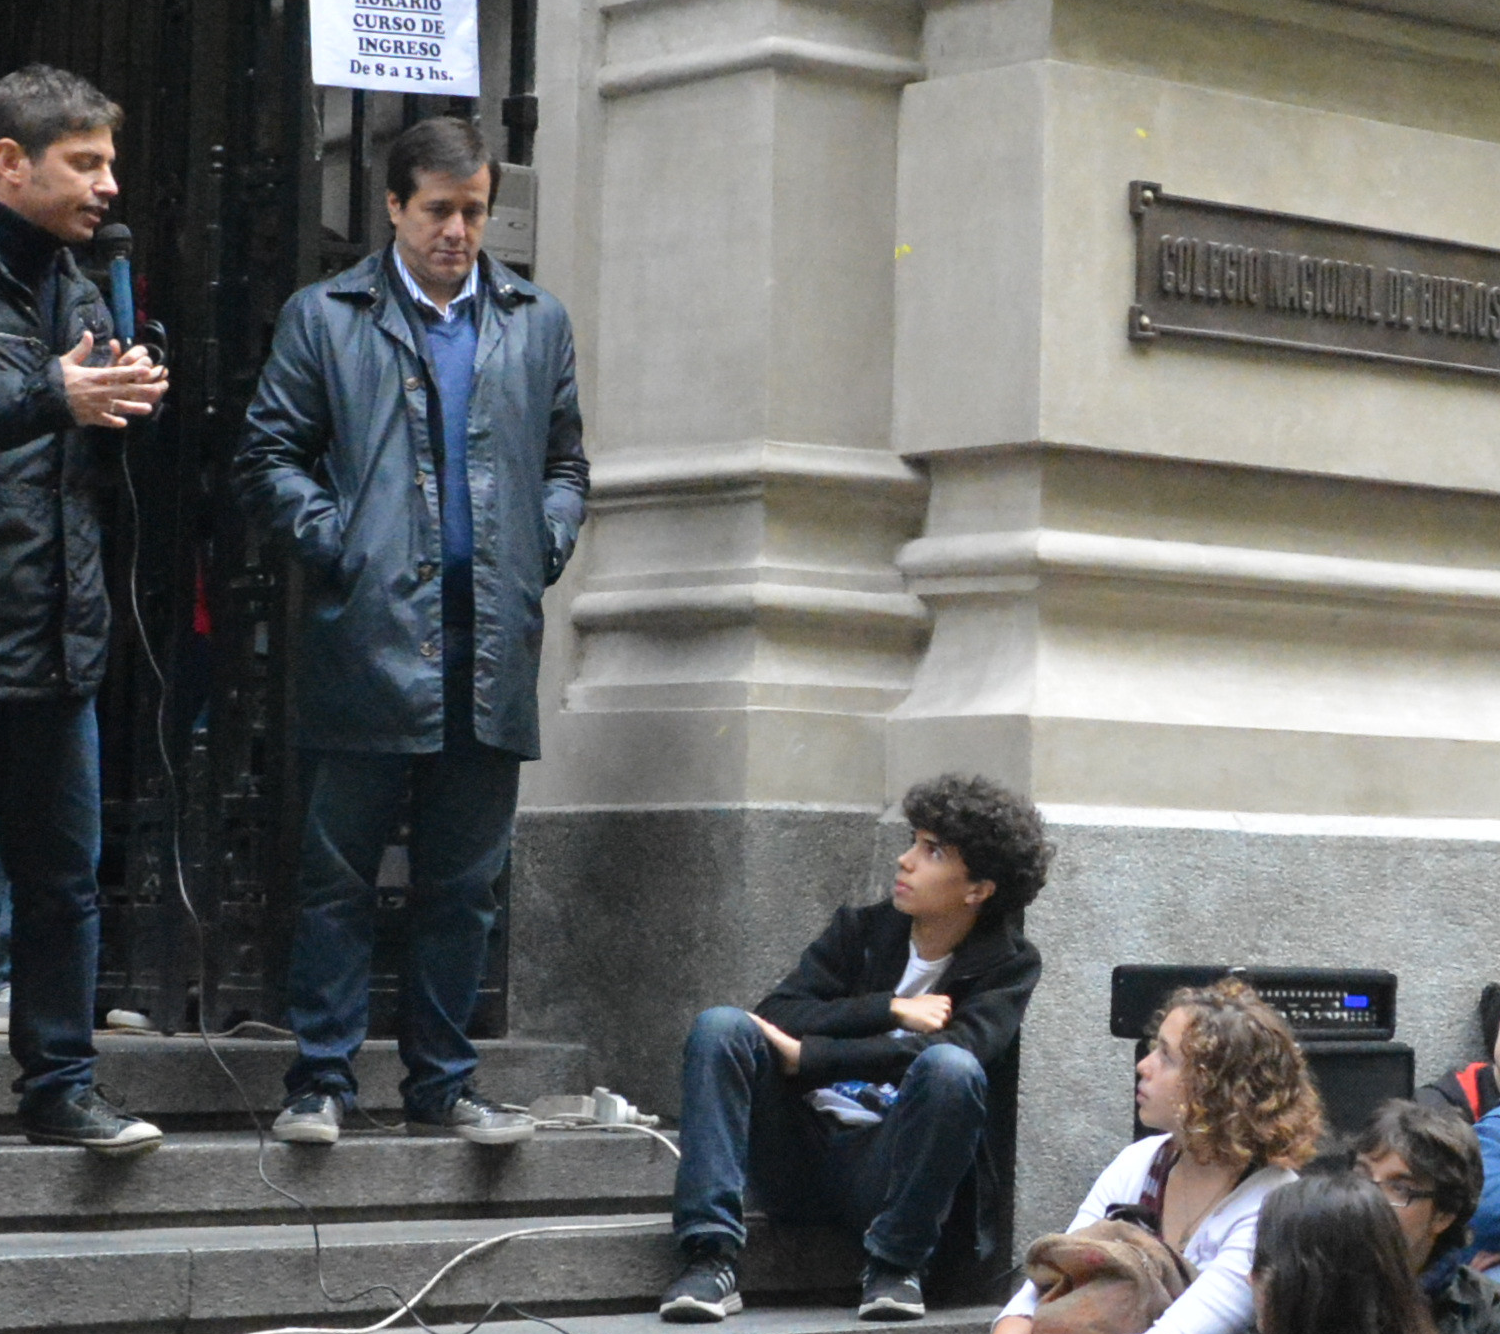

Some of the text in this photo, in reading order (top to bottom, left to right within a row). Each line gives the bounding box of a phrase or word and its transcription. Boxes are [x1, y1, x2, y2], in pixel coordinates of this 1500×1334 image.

[353, 13, 445, 35] CURSO DE
[358, 37, 441, 57] INGRESO
[350, 59, 454, 82] De 8 a 13 hs.
[1159, 233, 1260, 305] COLEGIO
[1266, 249, 1381, 323] NACIONAL
[1384, 267, 1414, 330] DE
